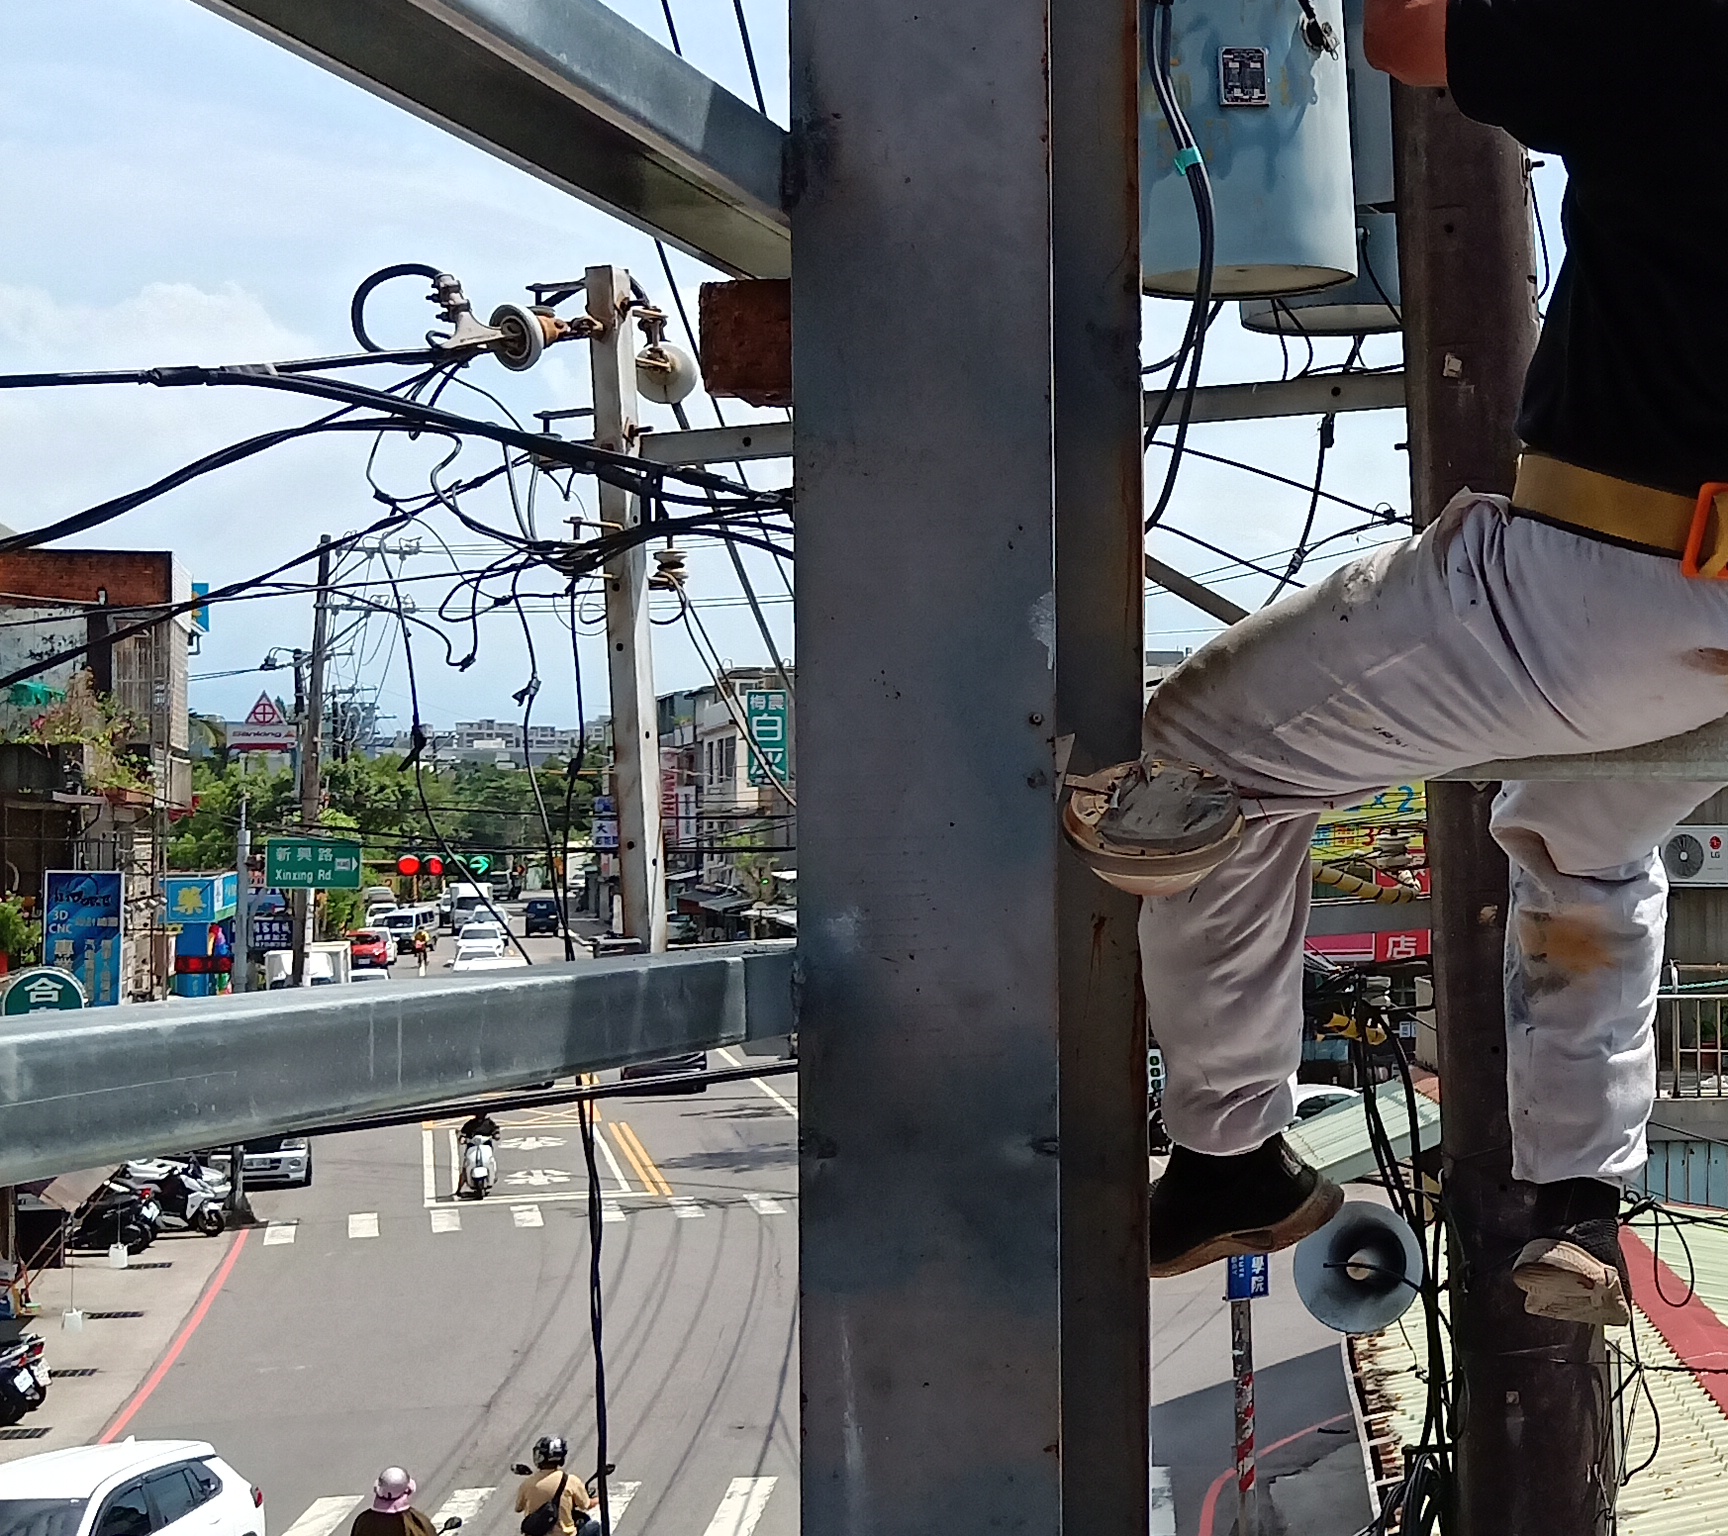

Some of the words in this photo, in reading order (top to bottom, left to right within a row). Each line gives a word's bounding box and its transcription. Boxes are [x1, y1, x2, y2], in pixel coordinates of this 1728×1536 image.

[276, 847, 333, 862] 新興路
[1710, 851, 1720, 859] LG
[275, 869, 314, 884] Xinxing
[318, 870, 334, 881] Rd.
[53, 910, 68, 921] 3D
[48, 923, 73, 934] CNC
[1387, 935, 1417, 960] 店
[24, 977, 64, 1013] 合
